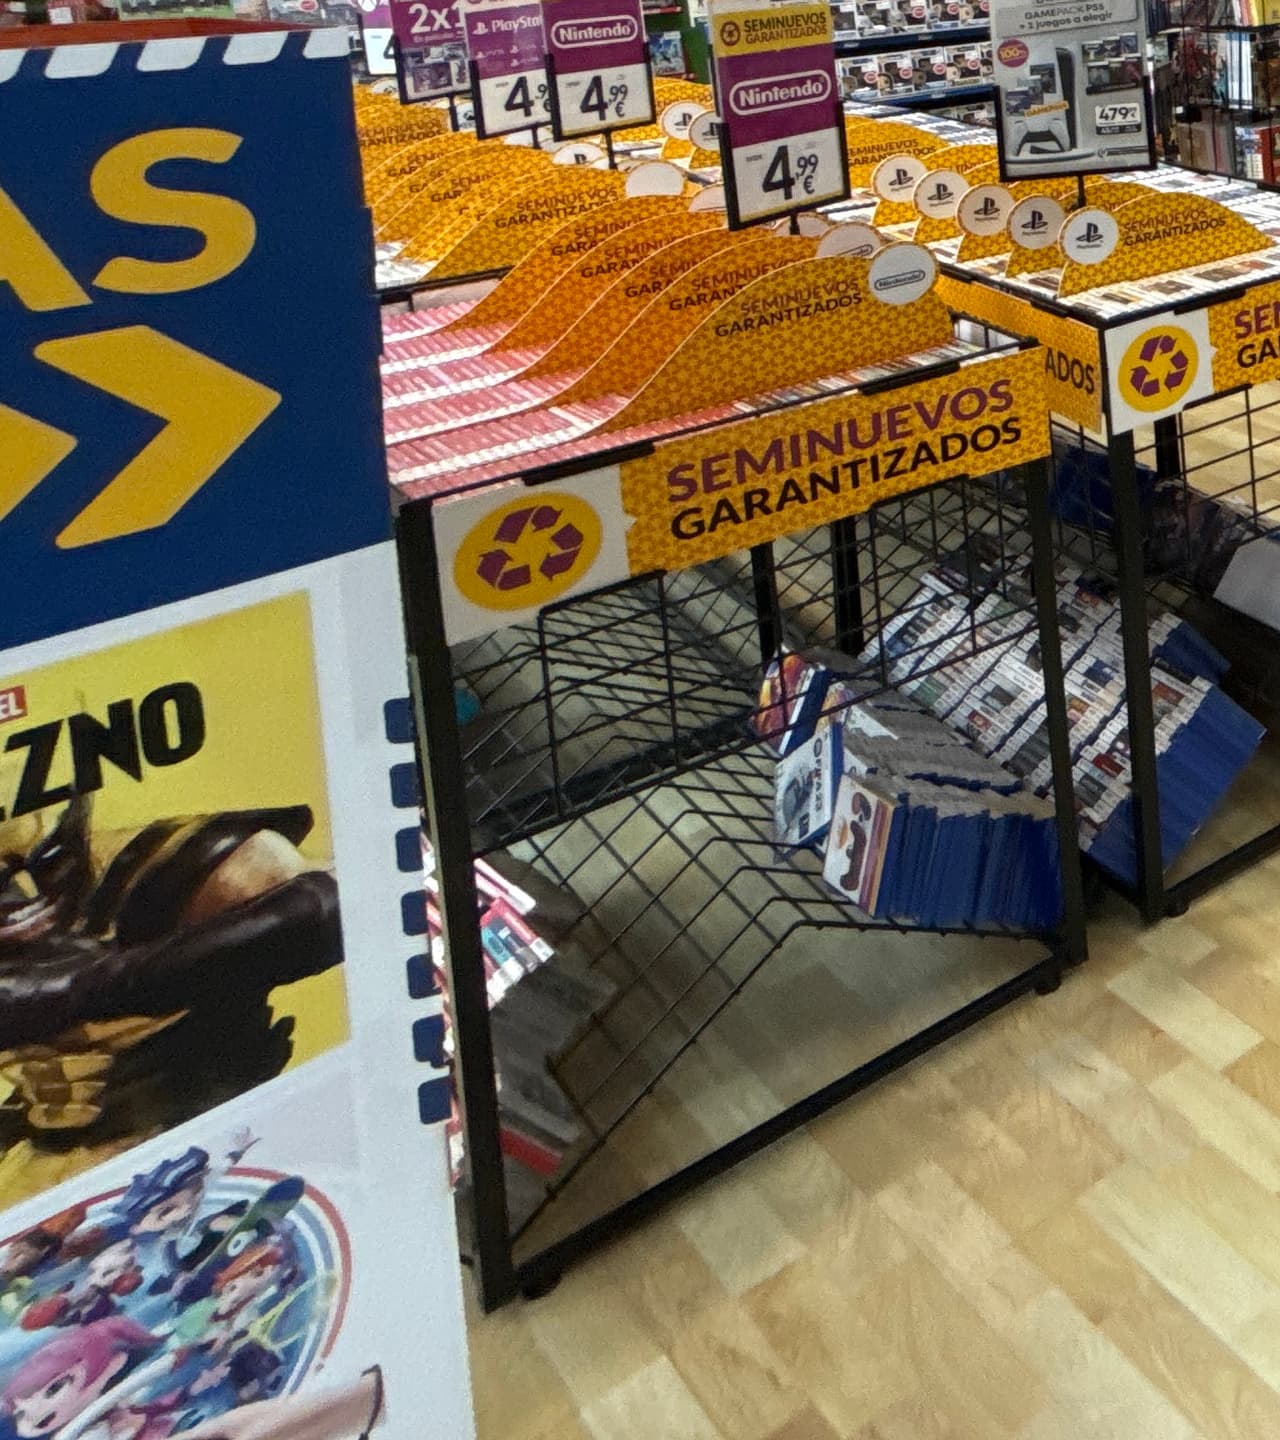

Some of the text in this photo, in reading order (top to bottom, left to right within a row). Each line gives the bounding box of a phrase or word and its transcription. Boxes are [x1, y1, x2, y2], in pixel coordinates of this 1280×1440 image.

[491, 16, 543, 33] PlaySta
[560, 23, 631, 43] Nintendo
[743, 12, 827, 34] SEMINUEVOS
[745, 25, 828, 45] GARANTIZADOS
[739, 79, 823, 108] Nintendo
[517, 186, 619, 213] SEMINUEVOS
[1124, 209, 1208, 233] SEMINUEVOS
[1124, 216, 1225, 247] GARANTIZADOS
[740, 278, 859, 315] SEMINUEVOS
[715, 293, 863, 338] GARANTIZADOS
[667, 378, 1014, 504] SEMINUEVOS
[670, 415, 1022, 540] GARANTIZADOS
